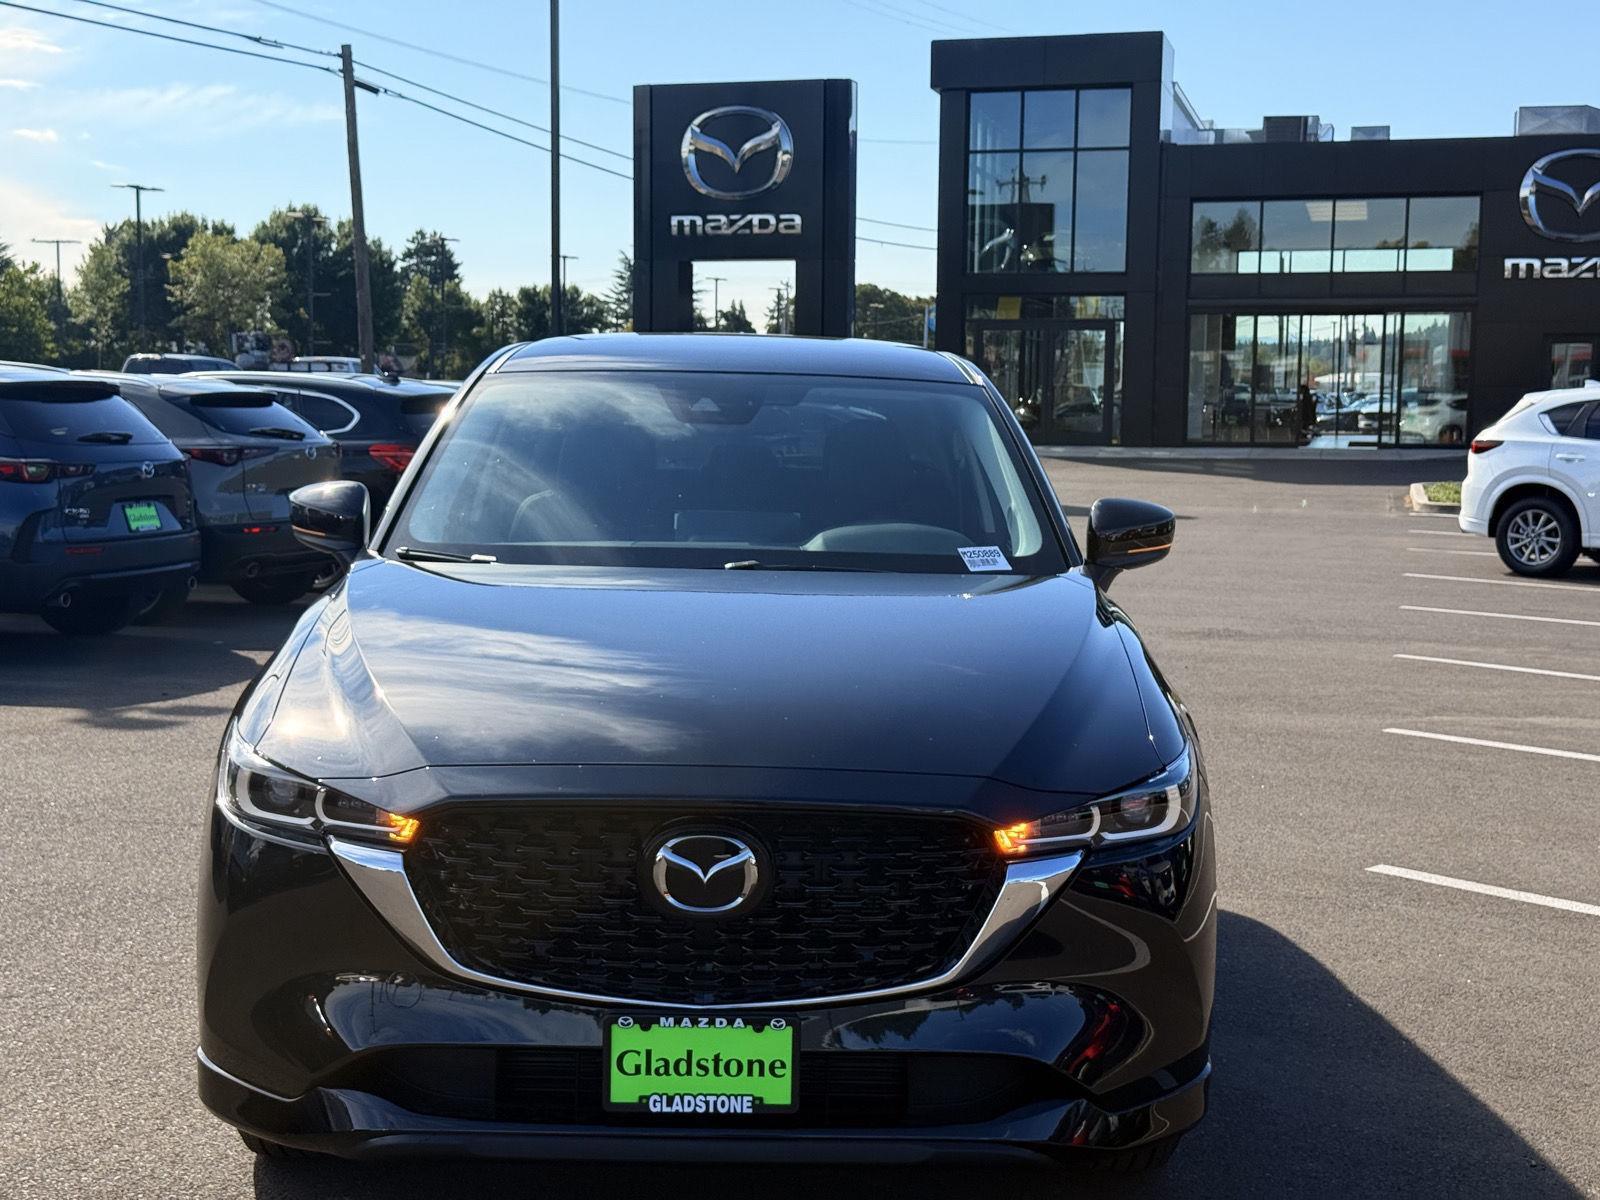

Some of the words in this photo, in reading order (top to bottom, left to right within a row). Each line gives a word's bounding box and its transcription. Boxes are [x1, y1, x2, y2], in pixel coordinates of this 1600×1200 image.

[670, 214, 802, 236] mazda
[1503, 257, 1600, 279] maz
[660, 1017, 746, 1028] MAZDA
[616, 1049, 787, 1078] Gladstone
[649, 1094, 753, 1114] GLADSTONE
